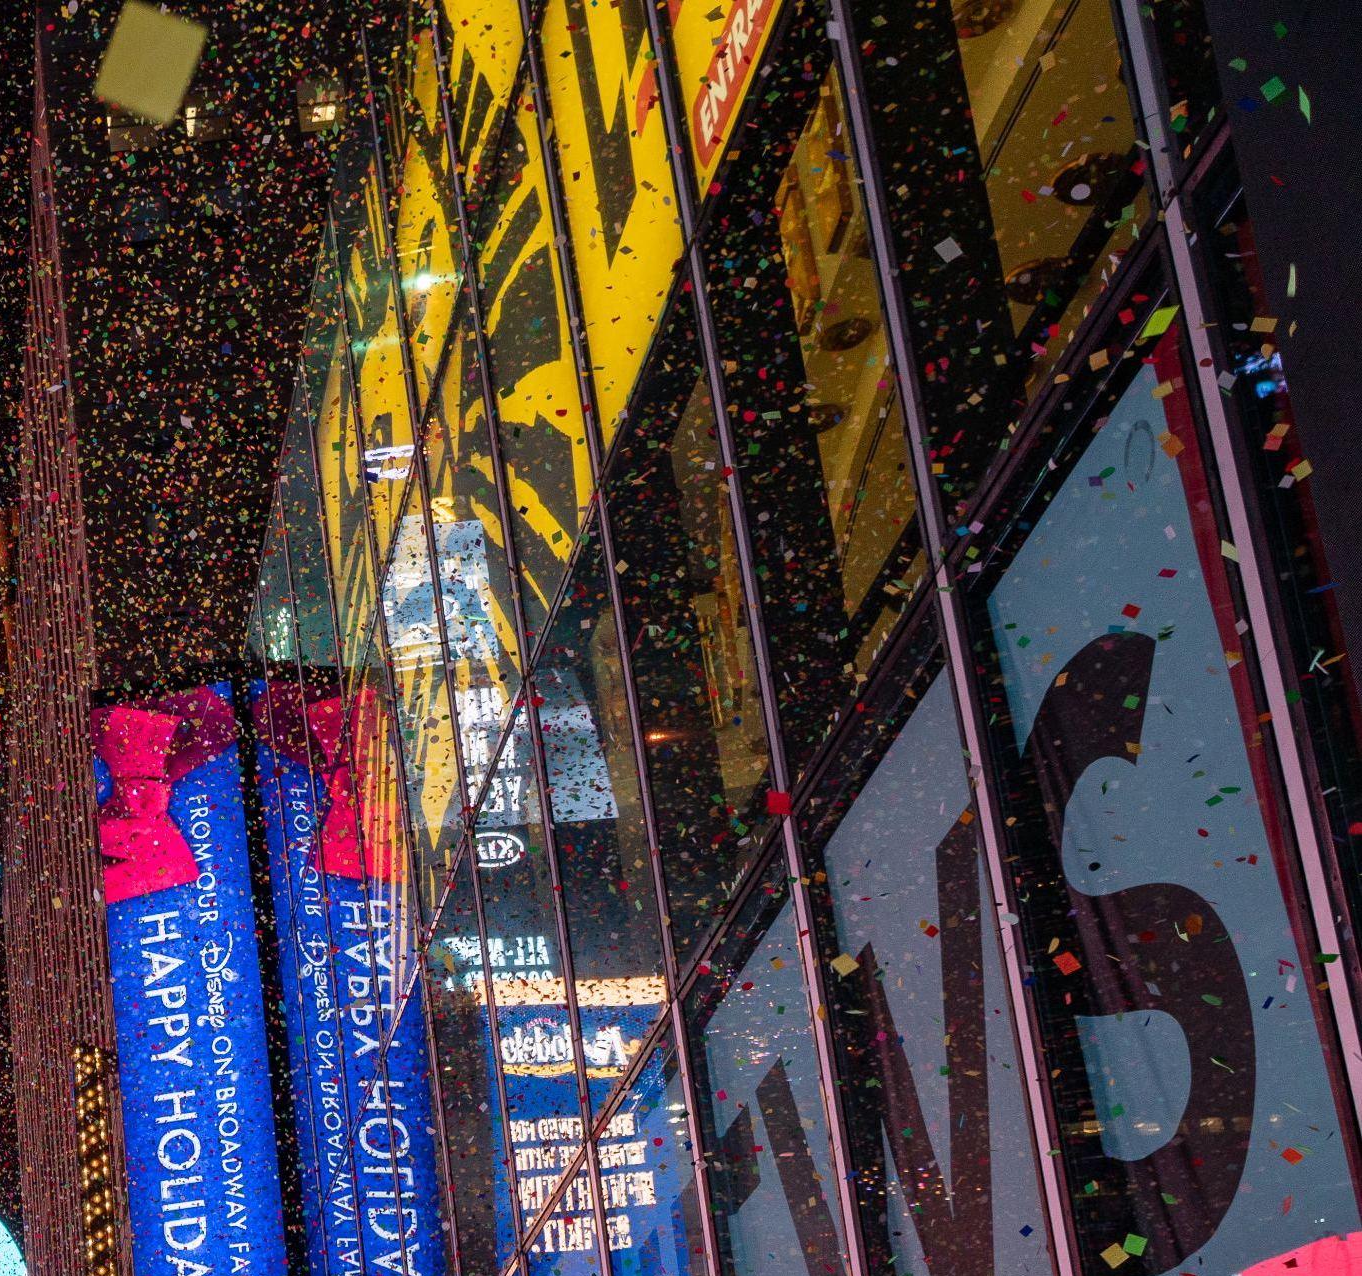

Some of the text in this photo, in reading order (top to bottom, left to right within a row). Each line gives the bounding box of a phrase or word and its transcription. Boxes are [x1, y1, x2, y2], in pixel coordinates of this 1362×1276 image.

[187, 793, 213, 862] FROM
[196, 870, 220, 925] OUR
[140, 910, 194, 1068] HAPPY
[211, 1036, 234, 1077] ON
[215, 1085, 248, 1230] BROADWAY
